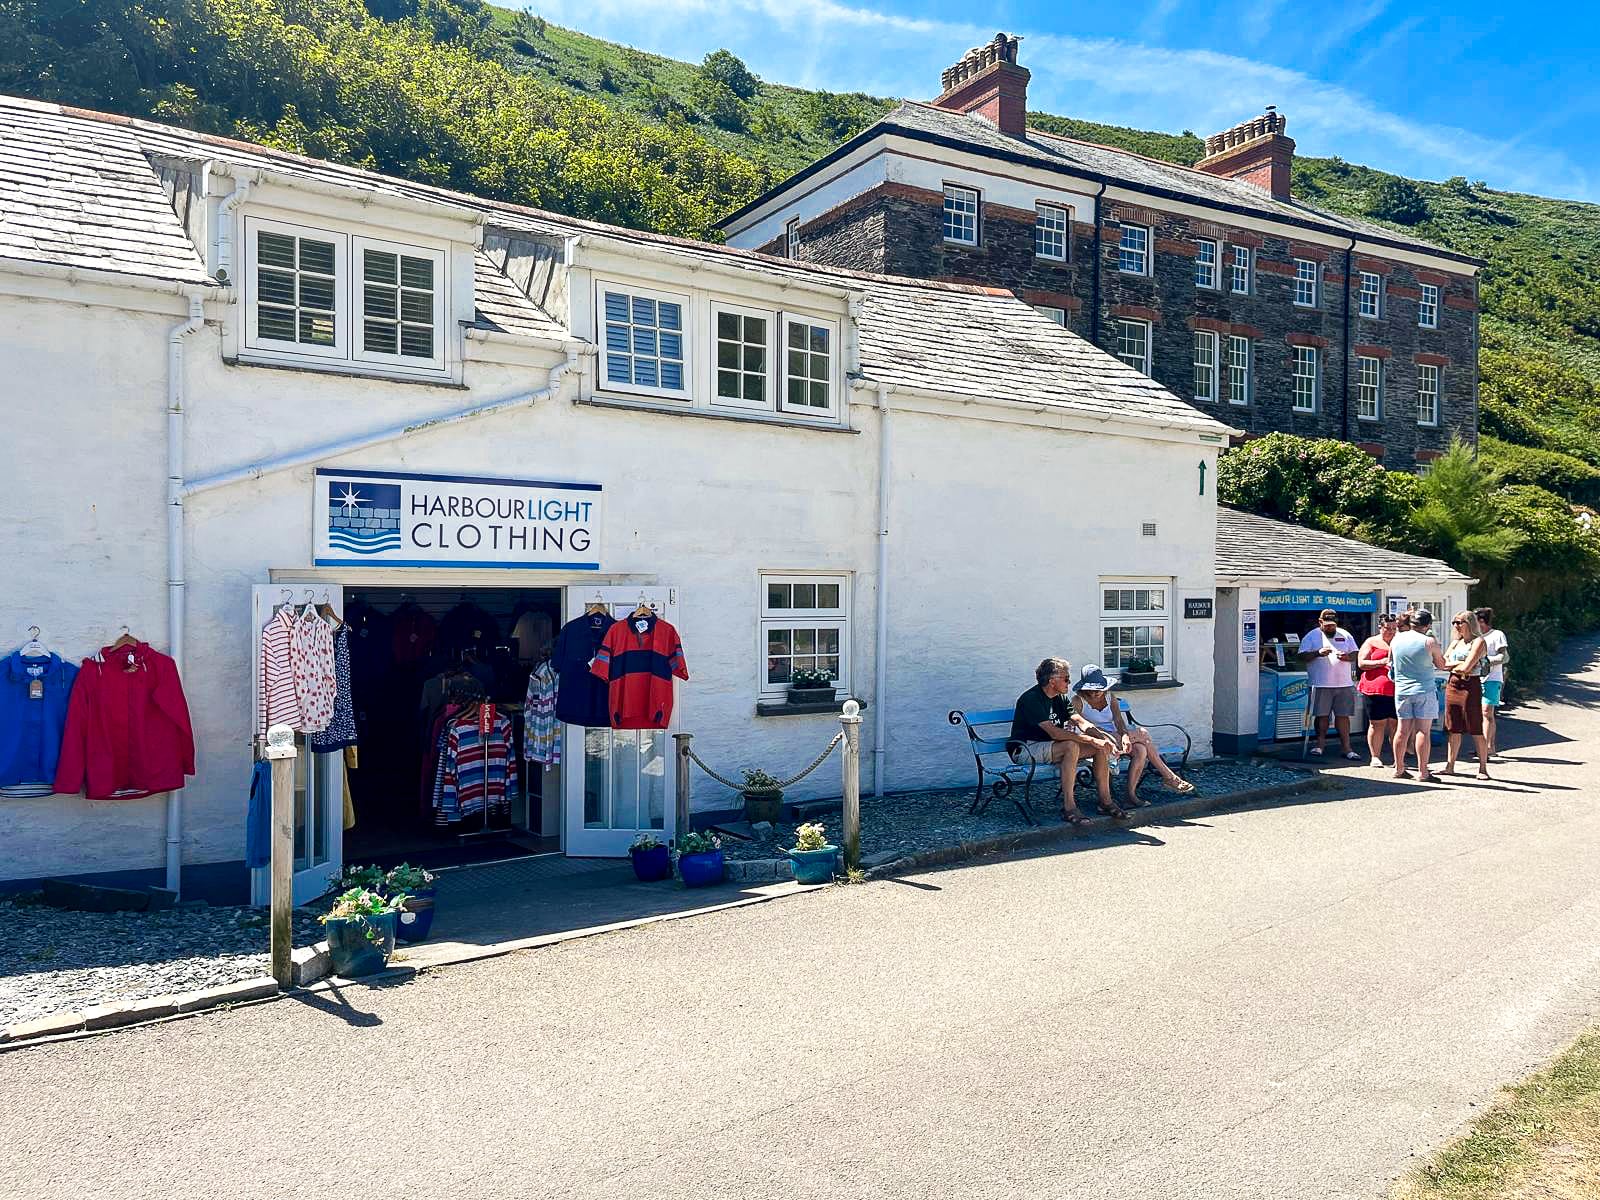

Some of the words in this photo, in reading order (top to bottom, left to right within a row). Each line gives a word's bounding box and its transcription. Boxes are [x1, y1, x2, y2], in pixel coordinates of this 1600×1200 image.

[411, 494, 592, 522] HARBOURLIGHT
[411, 522, 591, 552] CLOTHING
[1292, 594, 1310, 605] LIGHT
